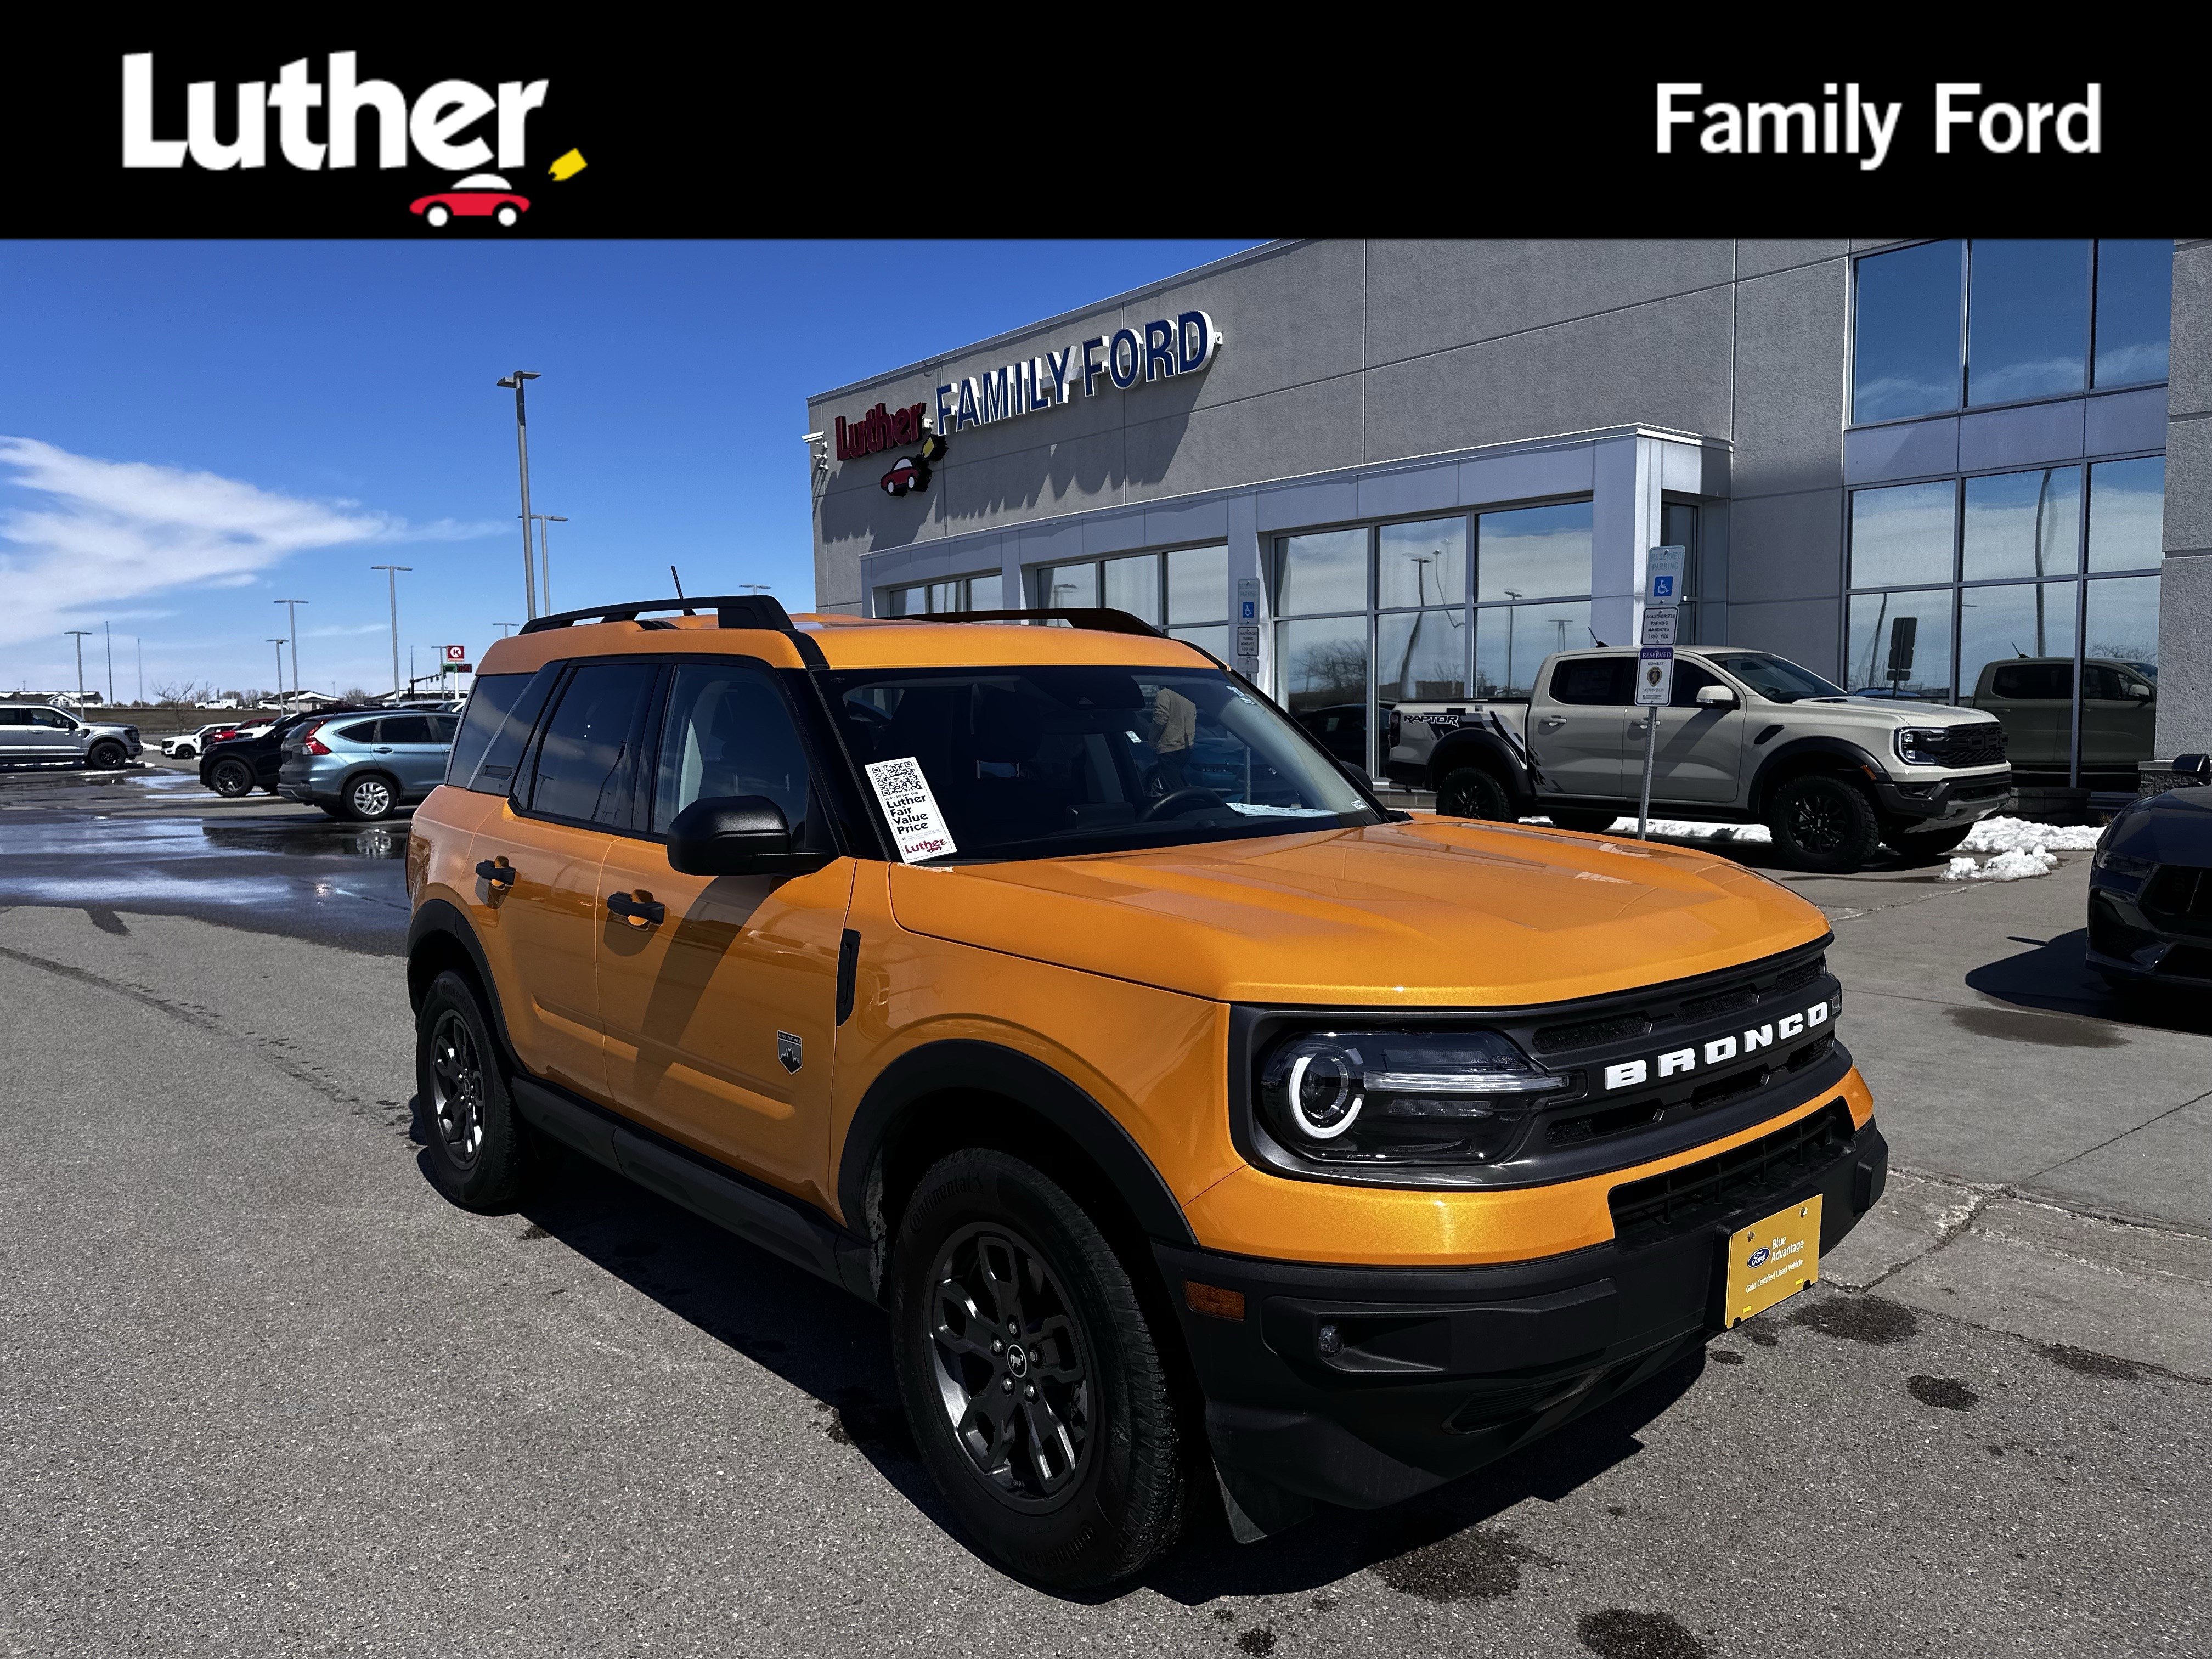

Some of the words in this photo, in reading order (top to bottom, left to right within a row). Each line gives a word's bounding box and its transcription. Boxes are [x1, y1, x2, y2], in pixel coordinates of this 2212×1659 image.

[935, 345, 1076, 436] FAMILY
[1082, 310, 1215, 397] FORD
[835, 402, 926, 461] Luther
[1651, 551, 1682, 561] RESERVED
[1651, 562, 1679, 571] PARKING
[1403, 715, 1460, 729] RAPTOR
[886, 795, 926, 809] Luther
[889, 806, 912, 817] Fair
[892, 814, 928, 826] Value
[896, 822, 929, 835] Price
[905, 839, 944, 854] Luther
[1604, 1001, 1828, 1090] BRONCO
[910, 1172, 973, 1235] Continental
[1772, 1235, 1786, 1250] Blue
[1771, 1240, 1804, 1263] Advantage
[1746, 1280, 1757, 1293] Gold
[1757, 1272, 1776, 1288] Certified
[1776, 1265, 1788, 1278] Used
[1788, 1259, 1803, 1271] Vehicle
